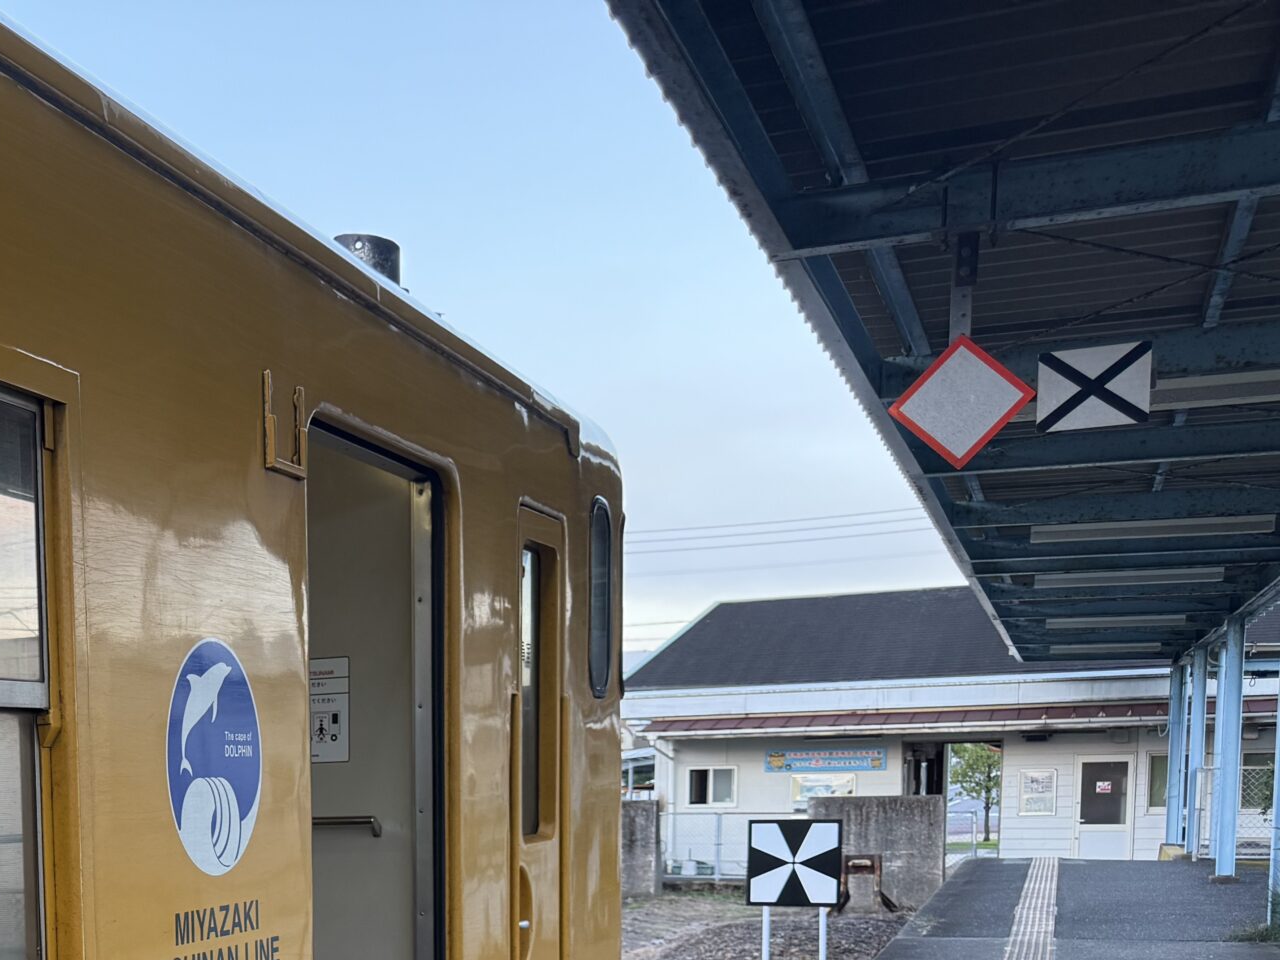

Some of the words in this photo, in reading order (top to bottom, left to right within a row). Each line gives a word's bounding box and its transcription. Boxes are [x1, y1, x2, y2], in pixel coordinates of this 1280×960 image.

[224, 731, 234, 741] The
[224, 744, 253, 757] DOLPHIN
[174, 899, 260, 946] MIYAZAKI
